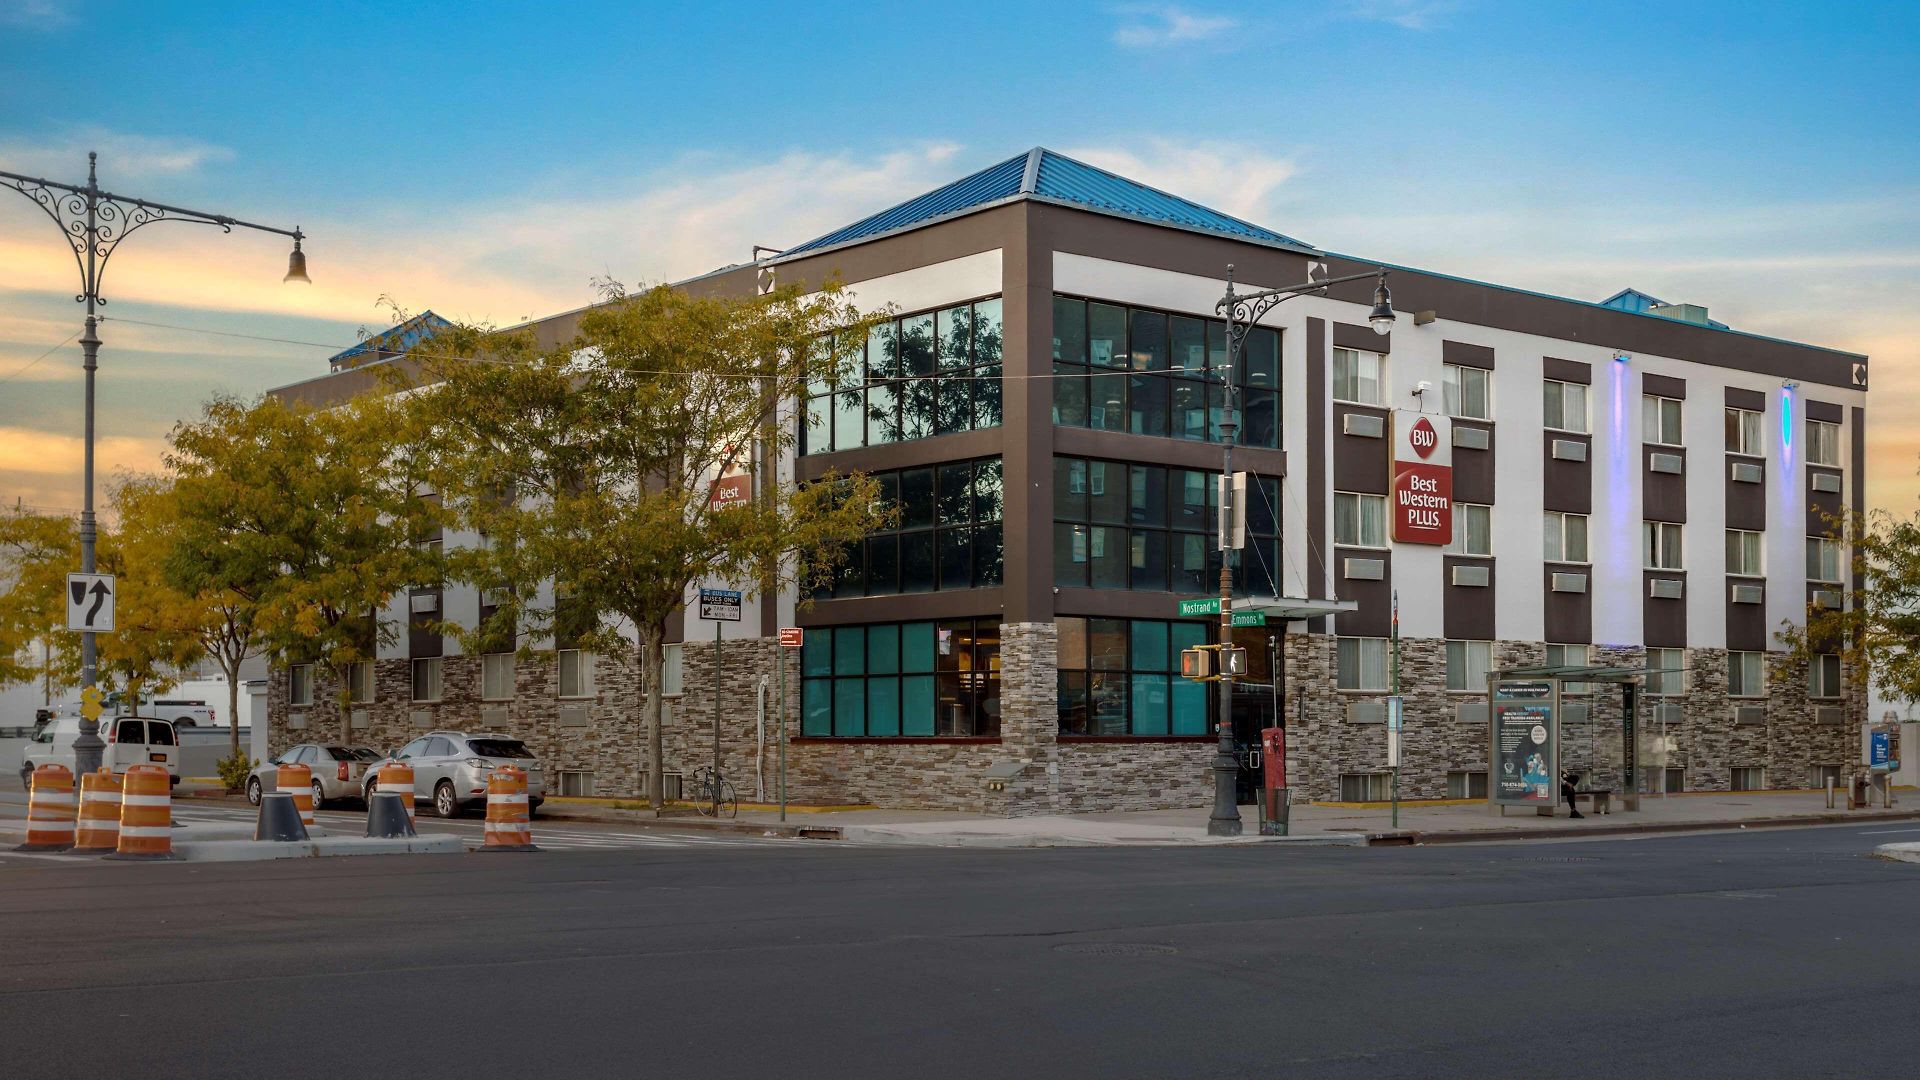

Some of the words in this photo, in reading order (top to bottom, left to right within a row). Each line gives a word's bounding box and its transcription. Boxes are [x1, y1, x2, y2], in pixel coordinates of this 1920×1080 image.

[1413, 429, 1434, 447] BW
[1411, 475, 1437, 492] Best
[720, 486, 739, 500] Best
[1399, 490, 1448, 509] Western
[1182, 602, 1211, 614] Nostrand
[1232, 614, 1257, 625] Emmons
